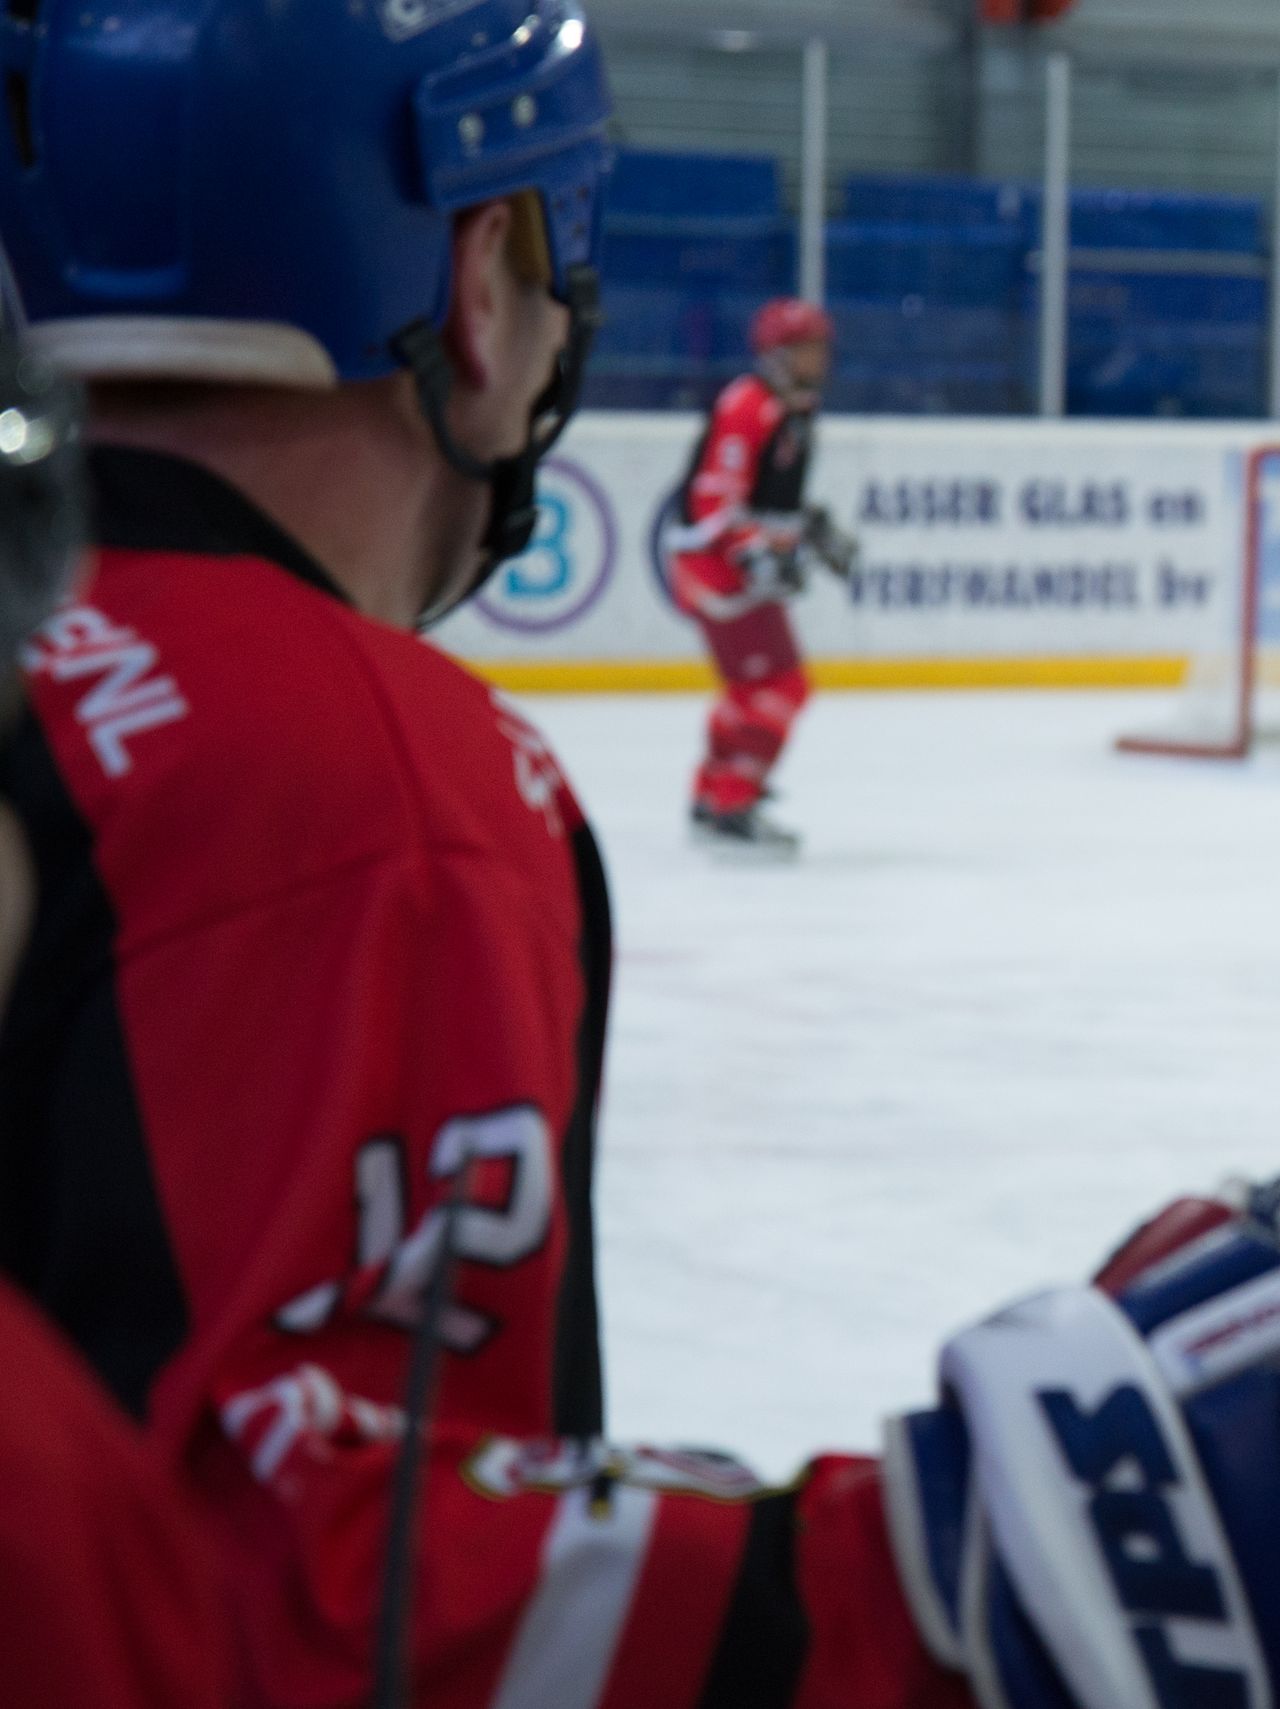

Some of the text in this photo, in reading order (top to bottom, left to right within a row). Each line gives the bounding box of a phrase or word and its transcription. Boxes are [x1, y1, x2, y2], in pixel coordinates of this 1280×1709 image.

[861, 478, 1204, 523] ASSER GLAS en
